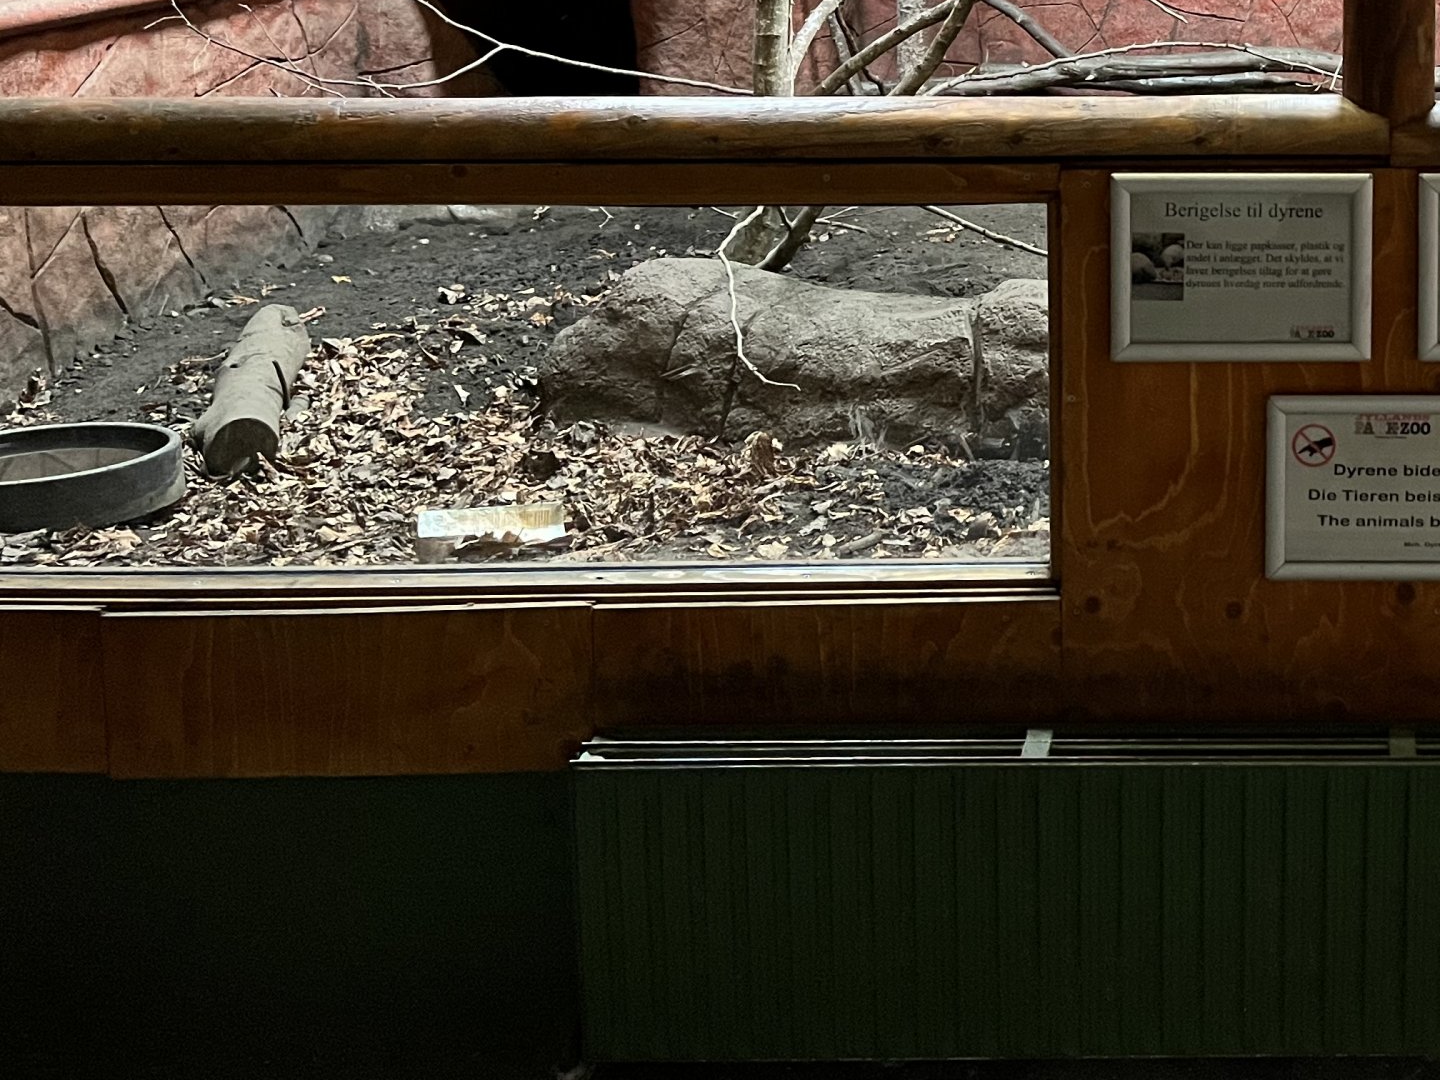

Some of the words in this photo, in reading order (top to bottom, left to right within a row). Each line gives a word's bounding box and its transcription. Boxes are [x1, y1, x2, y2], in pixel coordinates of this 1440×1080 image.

[1164, 202, 1241, 220] Berigelse
[1247, 203, 1263, 218] til
[1268, 203, 1323, 222] dyrene
[1186, 241, 1202, 249] Der
[1334, 464, 1397, 478] Dyrene
[1308, 489, 1337, 502] Die
[1343, 489, 1399, 502] Tieren
[1317, 515, 1350, 527] The
[1356, 515, 1424, 528] animals
